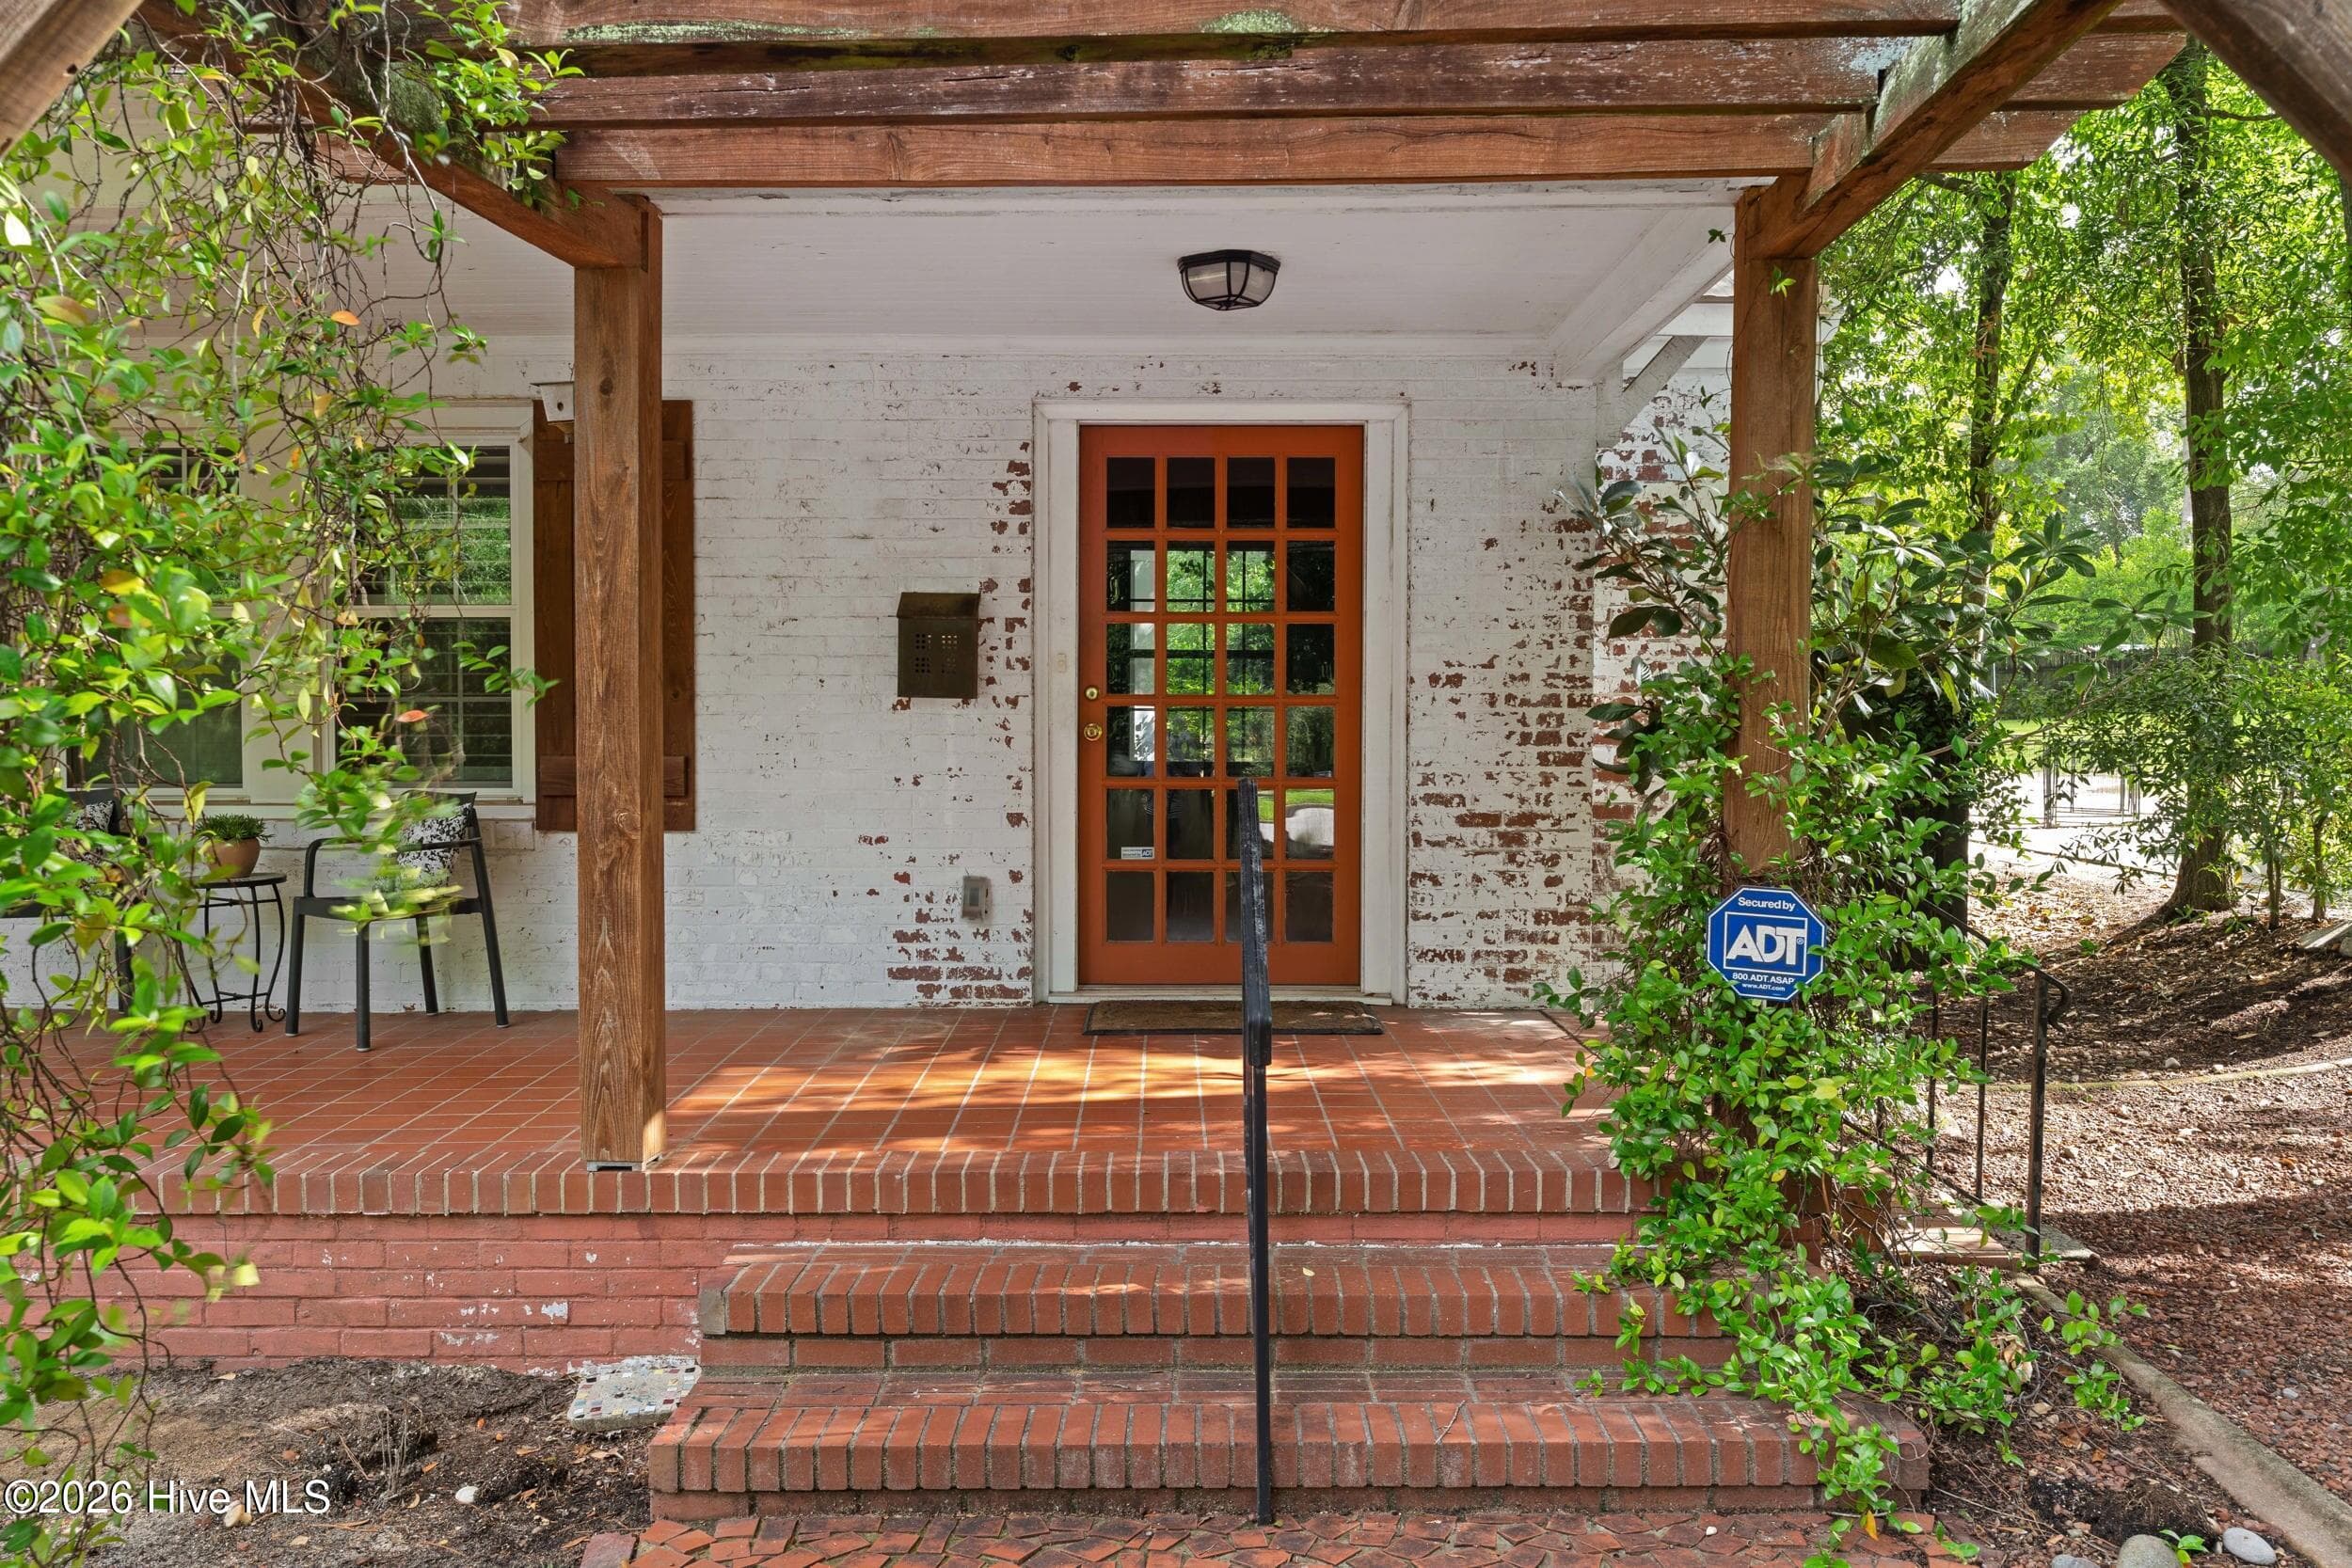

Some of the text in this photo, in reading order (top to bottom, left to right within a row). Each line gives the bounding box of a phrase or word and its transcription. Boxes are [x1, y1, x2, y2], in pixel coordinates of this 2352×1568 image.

[1739, 897, 1795, 911] Secured by
[1732, 973, 1794, 984] 800.ADT.ASAP
[1741, 983, 1786, 991] www.ADT.com
